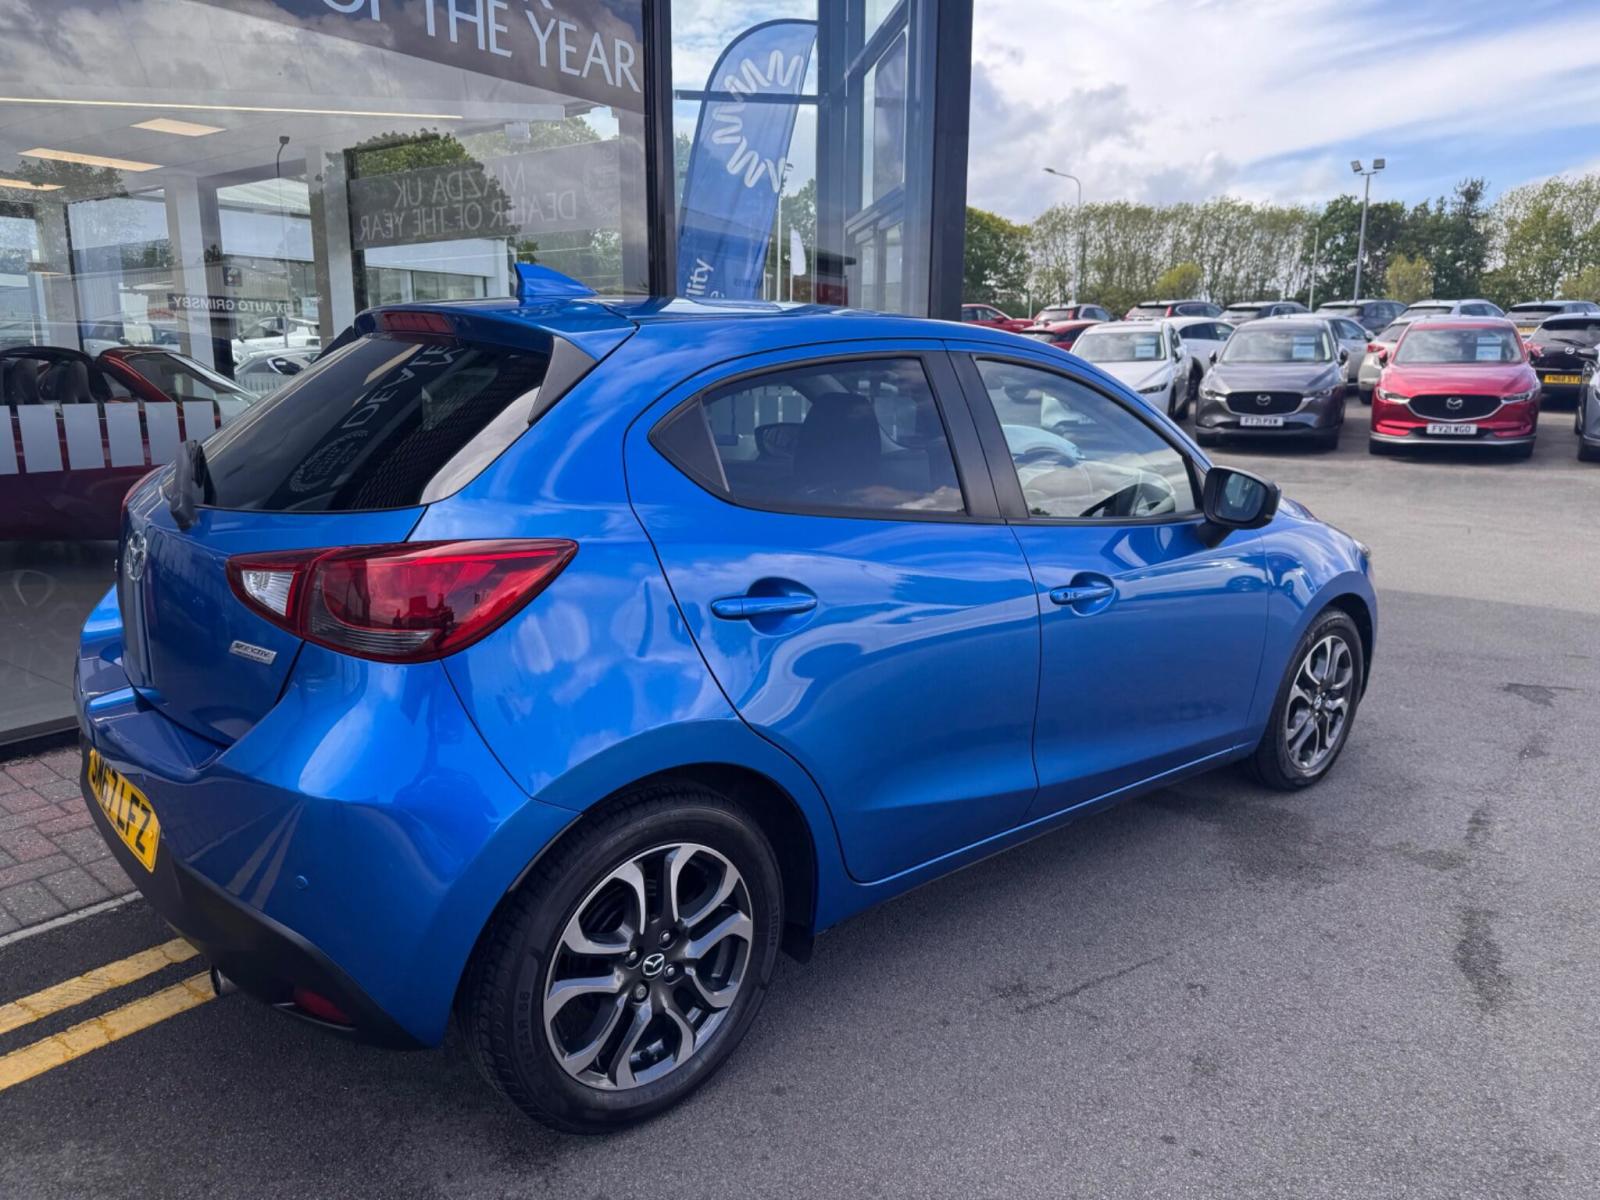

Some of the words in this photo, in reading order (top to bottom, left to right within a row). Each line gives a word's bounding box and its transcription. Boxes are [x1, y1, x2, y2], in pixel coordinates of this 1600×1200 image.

[525, 9, 641, 93] YEAR
[685, 257, 714, 297] lity
[117, 781, 151, 854] LFZ
